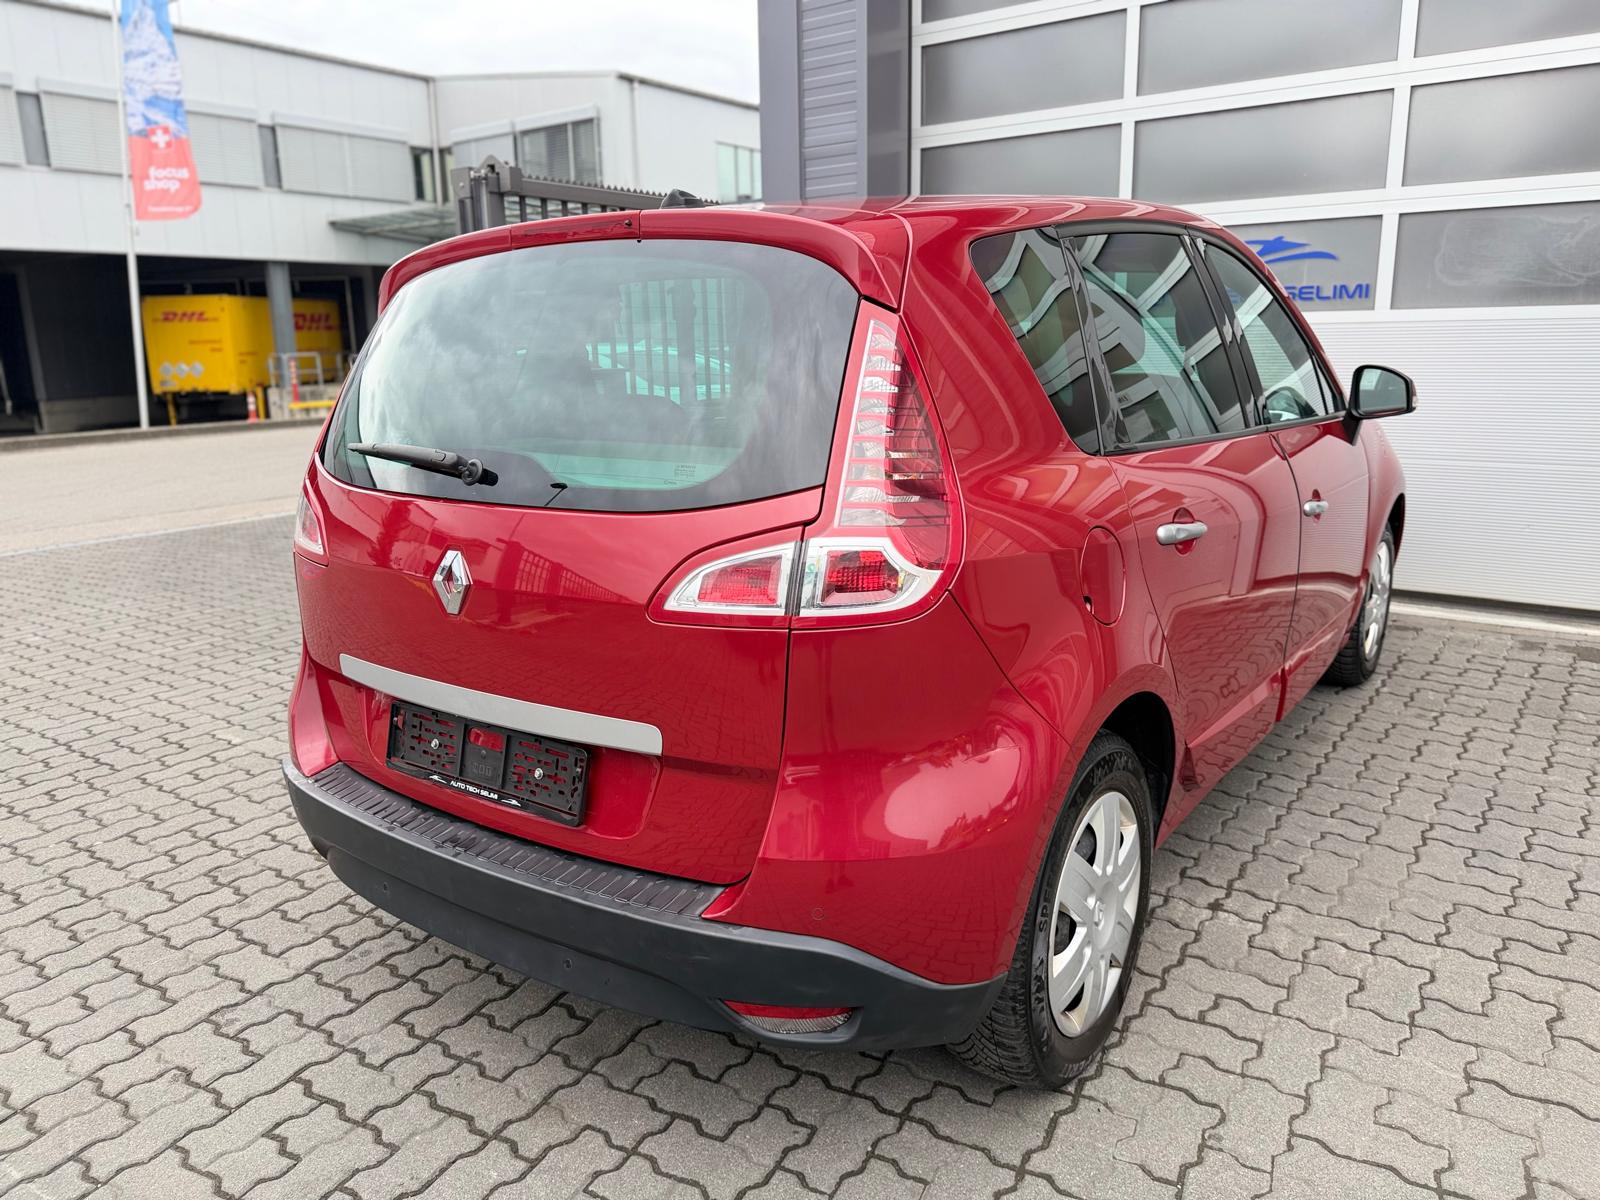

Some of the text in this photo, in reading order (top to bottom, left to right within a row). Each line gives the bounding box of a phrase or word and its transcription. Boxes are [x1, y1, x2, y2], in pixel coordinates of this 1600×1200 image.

[1285, 284, 1371, 301] SELIMI
[161, 310, 208, 323] DHL
[450, 780, 466, 789] AUTO
[466, 785, 480, 794] TECH
